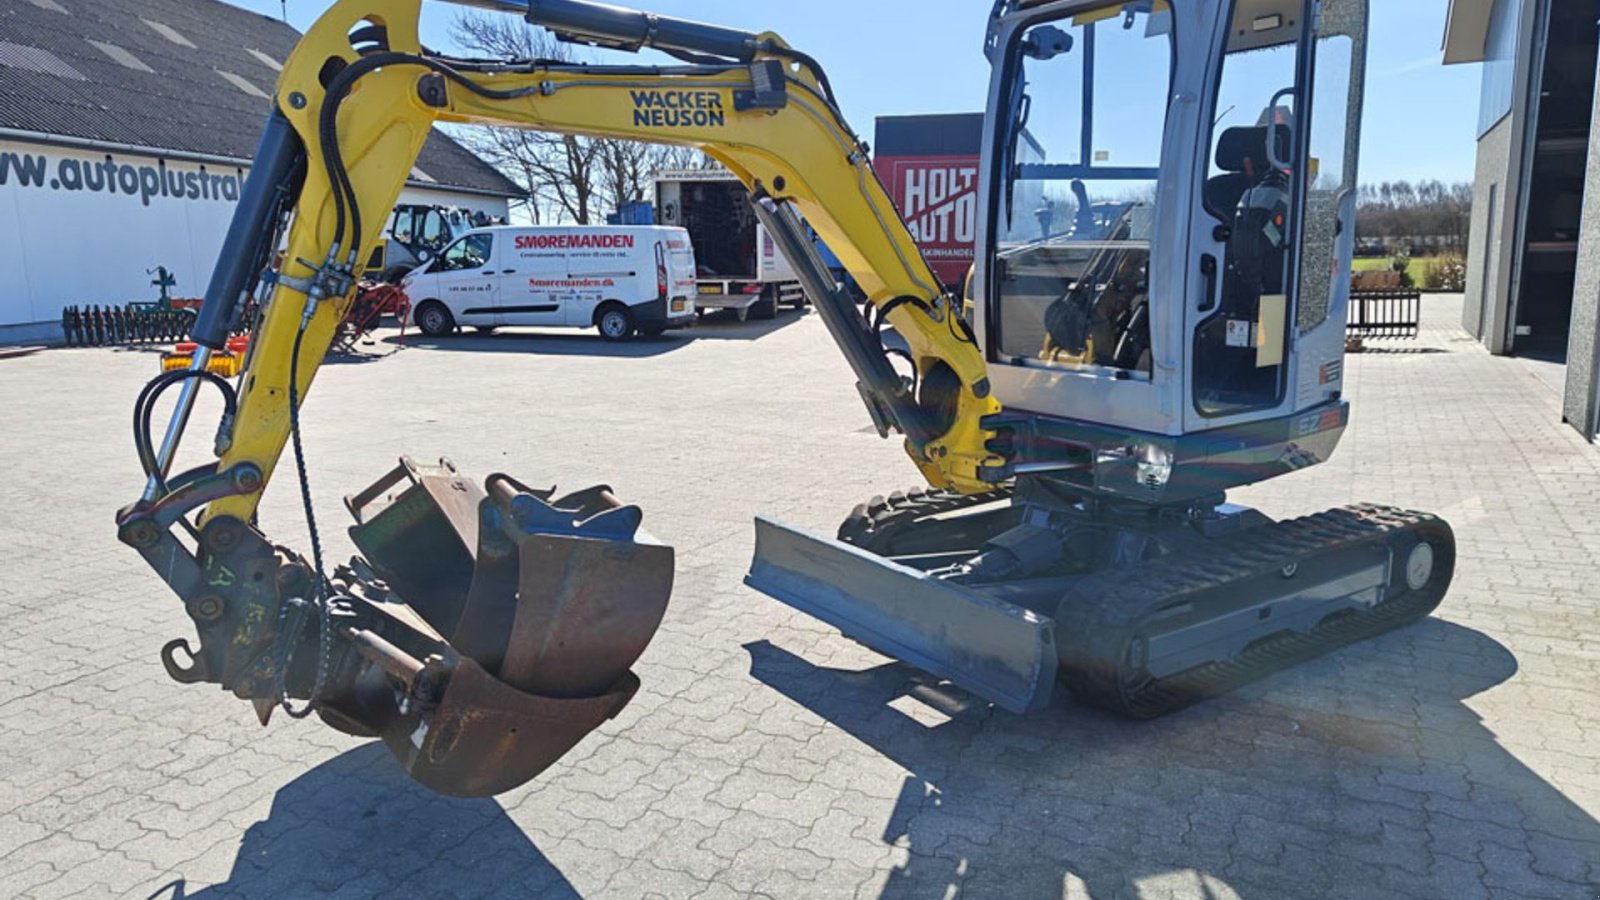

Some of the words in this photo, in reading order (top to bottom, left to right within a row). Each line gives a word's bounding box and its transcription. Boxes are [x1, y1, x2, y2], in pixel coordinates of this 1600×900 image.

[629, 90, 723, 109] WACKER
[633, 109, 725, 127] NEUSON
[904, 167, 977, 220] HOLT
[514, 234, 635, 250] SMØREMANDEN
